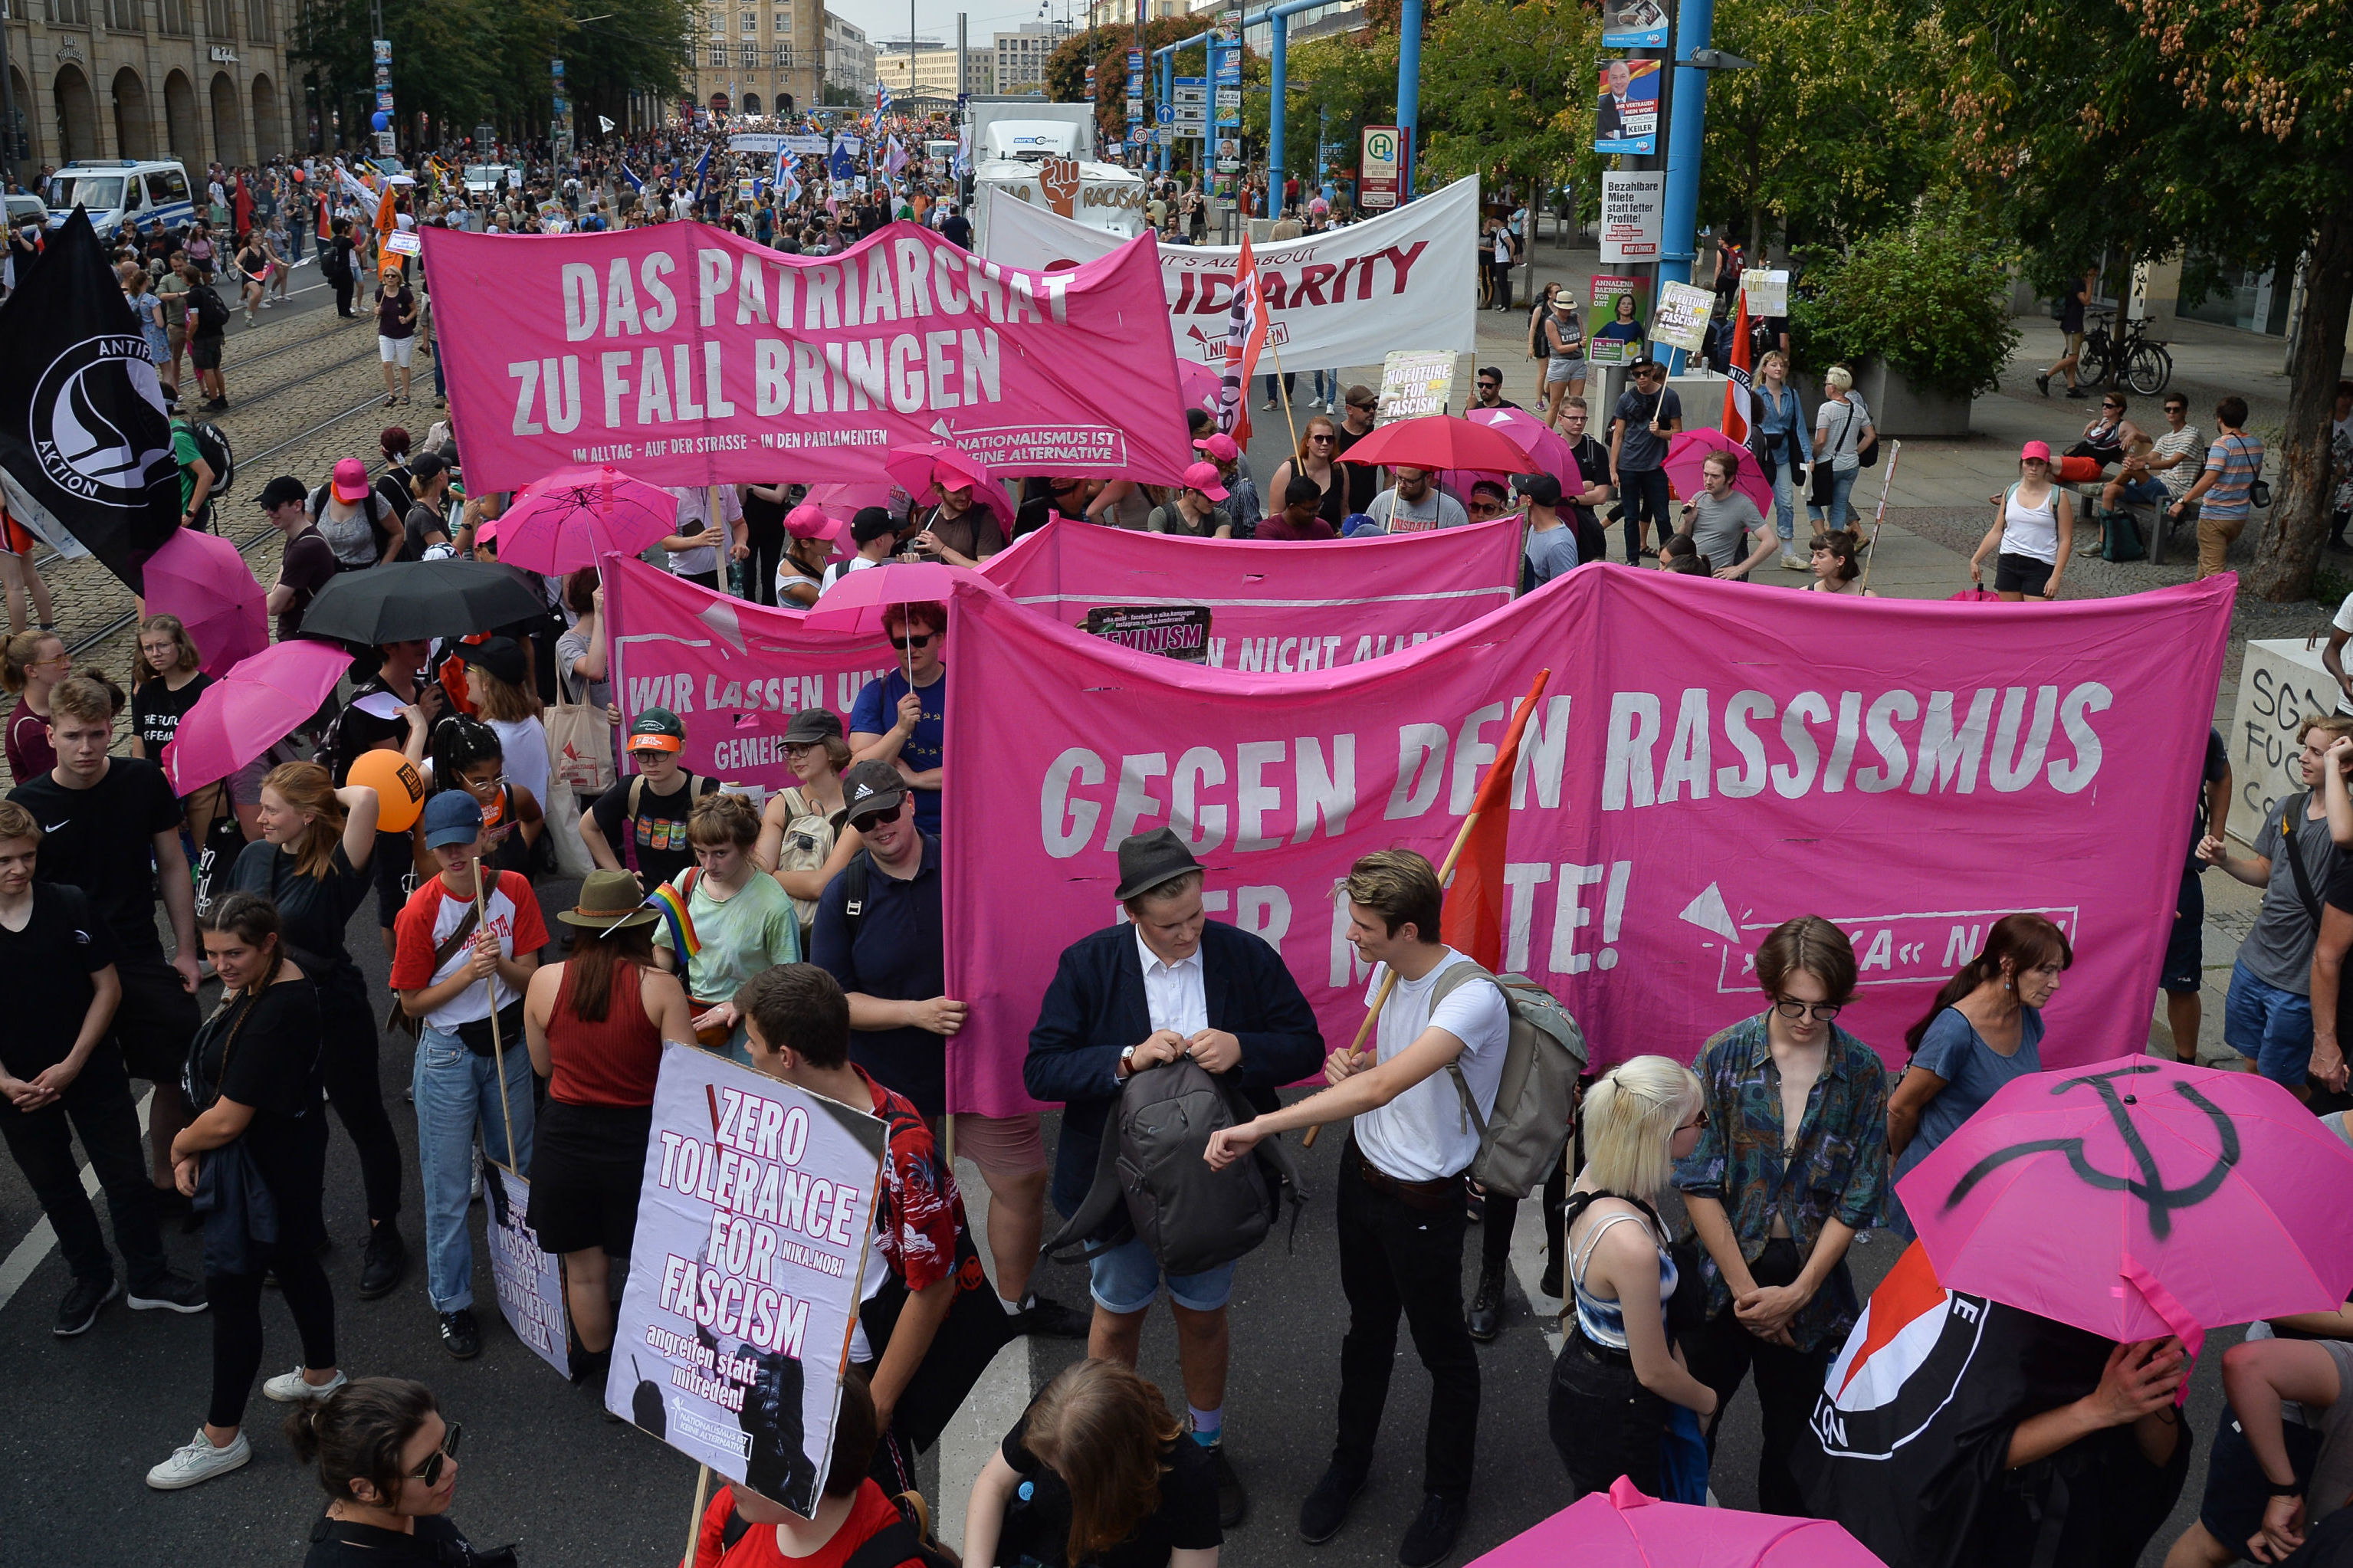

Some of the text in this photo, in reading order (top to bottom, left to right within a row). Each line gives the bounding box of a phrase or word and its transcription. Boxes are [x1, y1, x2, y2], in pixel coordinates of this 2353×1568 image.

[1626, 100, 1655, 109] VERTRAUEN
[1628, 124, 1652, 133] KEILER
[1374, 139, 1387, 154] H
[1083, 186, 1147, 213] RACISM
[1607, 192, 1635, 202] Miete
[1608, 182, 1659, 192] Bezahlbare
[1607, 203, 1653, 213] statt fetter
[1607, 214, 1641, 224] Profite!
[1252, 247, 1319, 266] ABOUT
[560, 237, 1075, 343] DAS PATRIARCHAT
[1663, 292, 1711, 310] NO FUTURE
[1662, 311, 1701, 328] FASCISM
[1675, 303, 1693, 316] FOR
[1561, 332, 1581, 342] LIEBE
[508, 327, 1001, 436] ZU FALL BRINGEN
[1386, 363, 1451, 385] NO FUTURE
[1403, 382, 1427, 399] FOR
[1387, 397, 1438, 417] FASCISM
[573, 429, 888, 463] IM ALLTAG AUF DER STRASSE IN DEN PARLAMENTEN
[956, 431, 1115, 451] NATIONALISMUS IST
[1009, 446, 1113, 461] ALTERNATIVE
[38, 440, 99, 497] AKTION
[1238, 635, 1341, 674] NICHT
[628, 672, 694, 717] WIR
[705, 674, 824, 715] LASSEN
[1041, 681, 2113, 859] GEGEN DEN RASSISMUS
[854, 789, 874, 801] adidas
[716, 1086, 810, 1166] ZERO
[658, 1129, 861, 1248] TOLERANCE
[498, 1224, 550, 1277] FASCISM
[704, 1209, 845, 1285] FOR NIKA.MOBI
[514, 1260, 540, 1296] FOR
[497, 1271, 563, 1337] TOLERANCE
[658, 1252, 810, 1361] FASCISM
[517, 1310, 549, 1351] ZERO
[646, 1325, 759, 1386] angreifen statt
[671, 1364, 747, 1412] mitreden!
[680, 1412, 749, 1445] NATIONALISMUS IST
[680, 1422, 747, 1452] KEINE ALTERNATIVE
